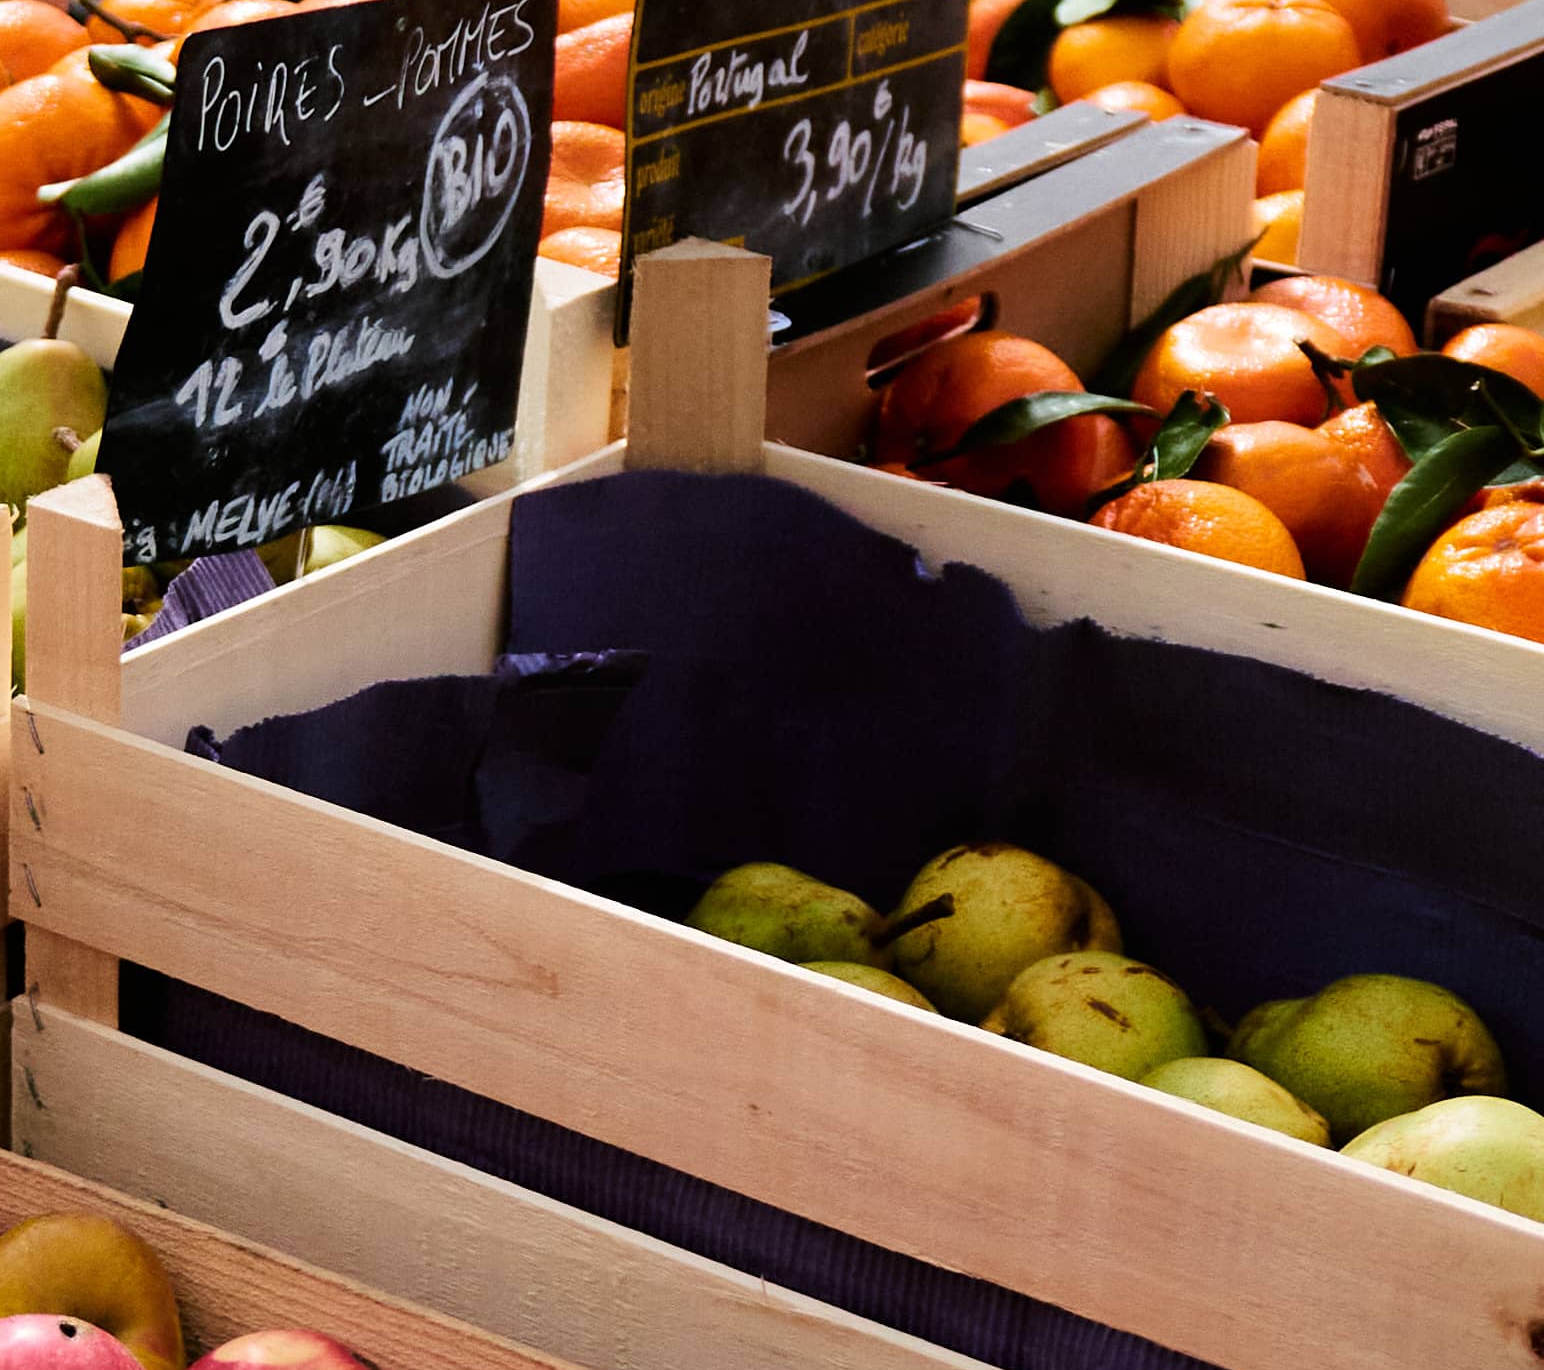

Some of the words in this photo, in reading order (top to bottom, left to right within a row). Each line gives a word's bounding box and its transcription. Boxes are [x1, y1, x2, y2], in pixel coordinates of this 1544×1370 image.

[686, 29, 809, 116] Portugal
[175, 356, 244, 429] 12
[398, 376, 455, 432] NON
[380, 428, 516, 504] BIOLOGIQUE
